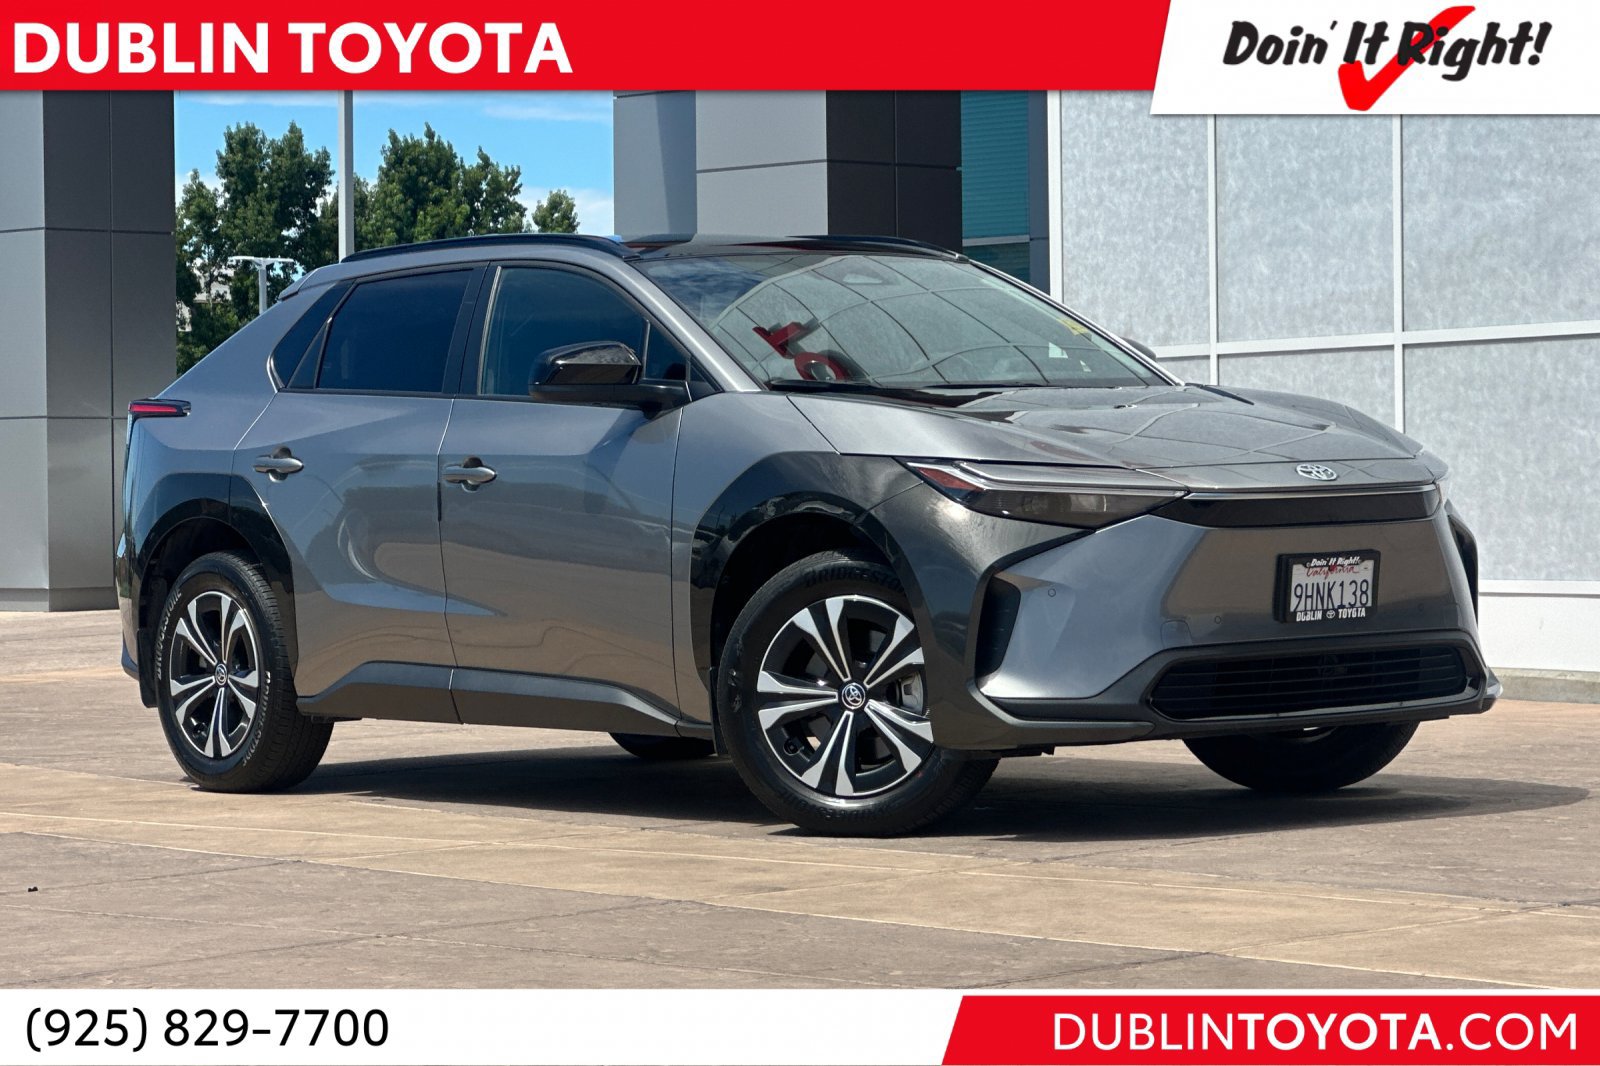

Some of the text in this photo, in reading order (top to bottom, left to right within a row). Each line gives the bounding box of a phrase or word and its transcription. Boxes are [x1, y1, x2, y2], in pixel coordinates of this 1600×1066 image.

[1336, 556, 1360, 567] Right!
[1294, 579, 1370, 611] 9HNK138
[1295, 607, 1366, 622] DUBLIN TOYOTA
